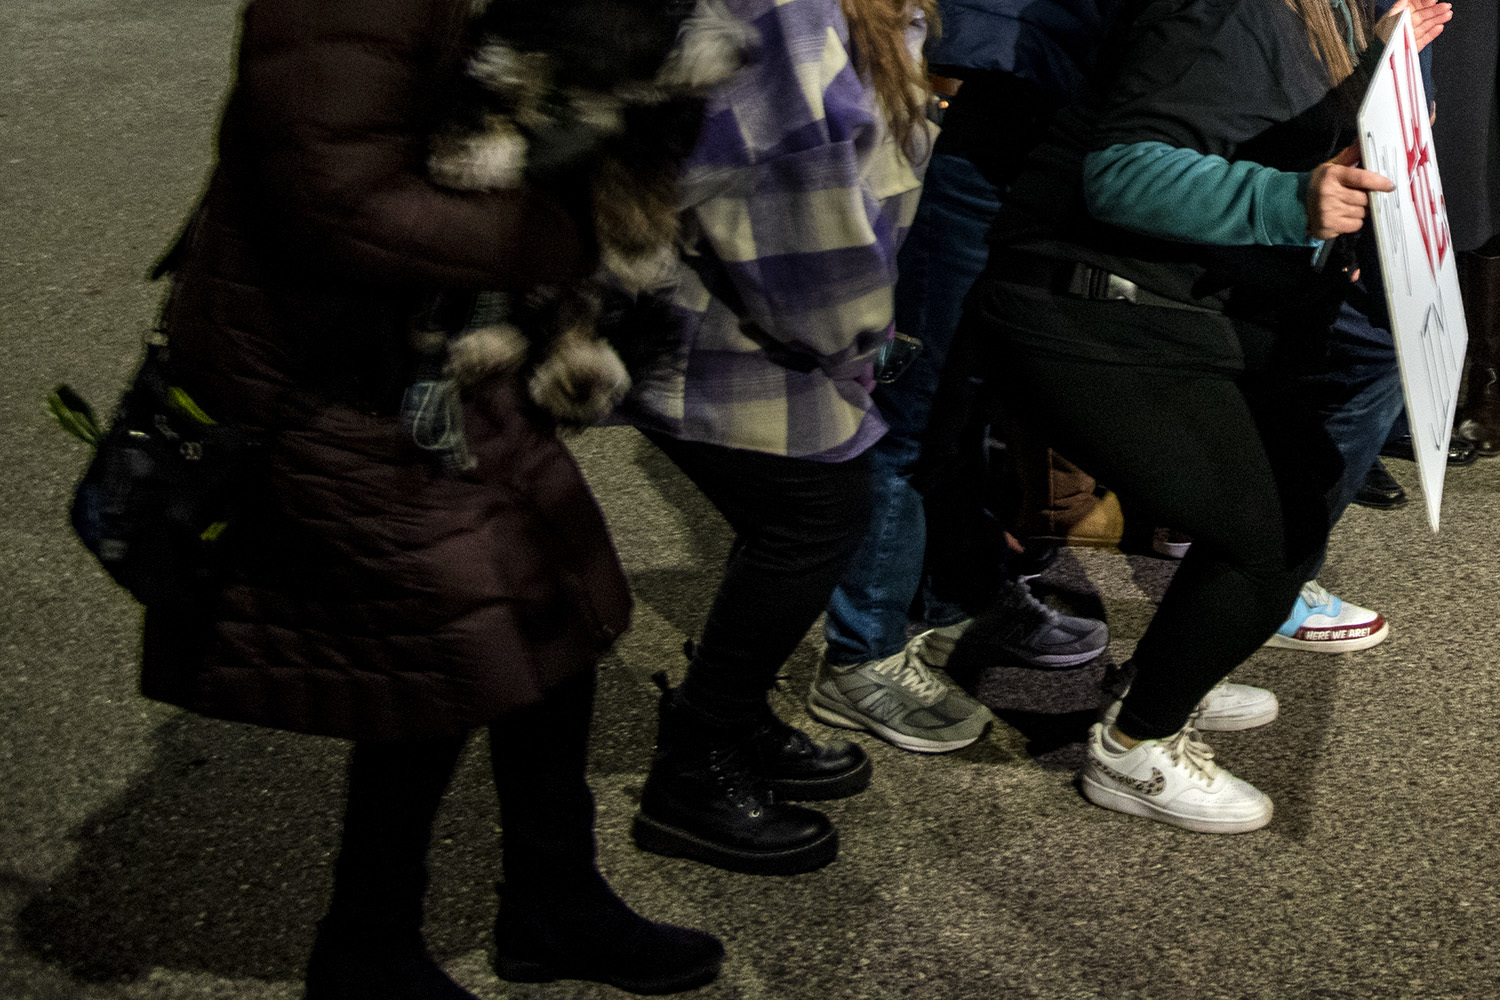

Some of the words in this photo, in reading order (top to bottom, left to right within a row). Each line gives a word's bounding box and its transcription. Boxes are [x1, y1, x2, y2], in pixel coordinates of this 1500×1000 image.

[1306, 630, 1329, 640] HERE
[1332, 629, 1346, 640] WE
[1349, 628, 1371, 638] ARE!
